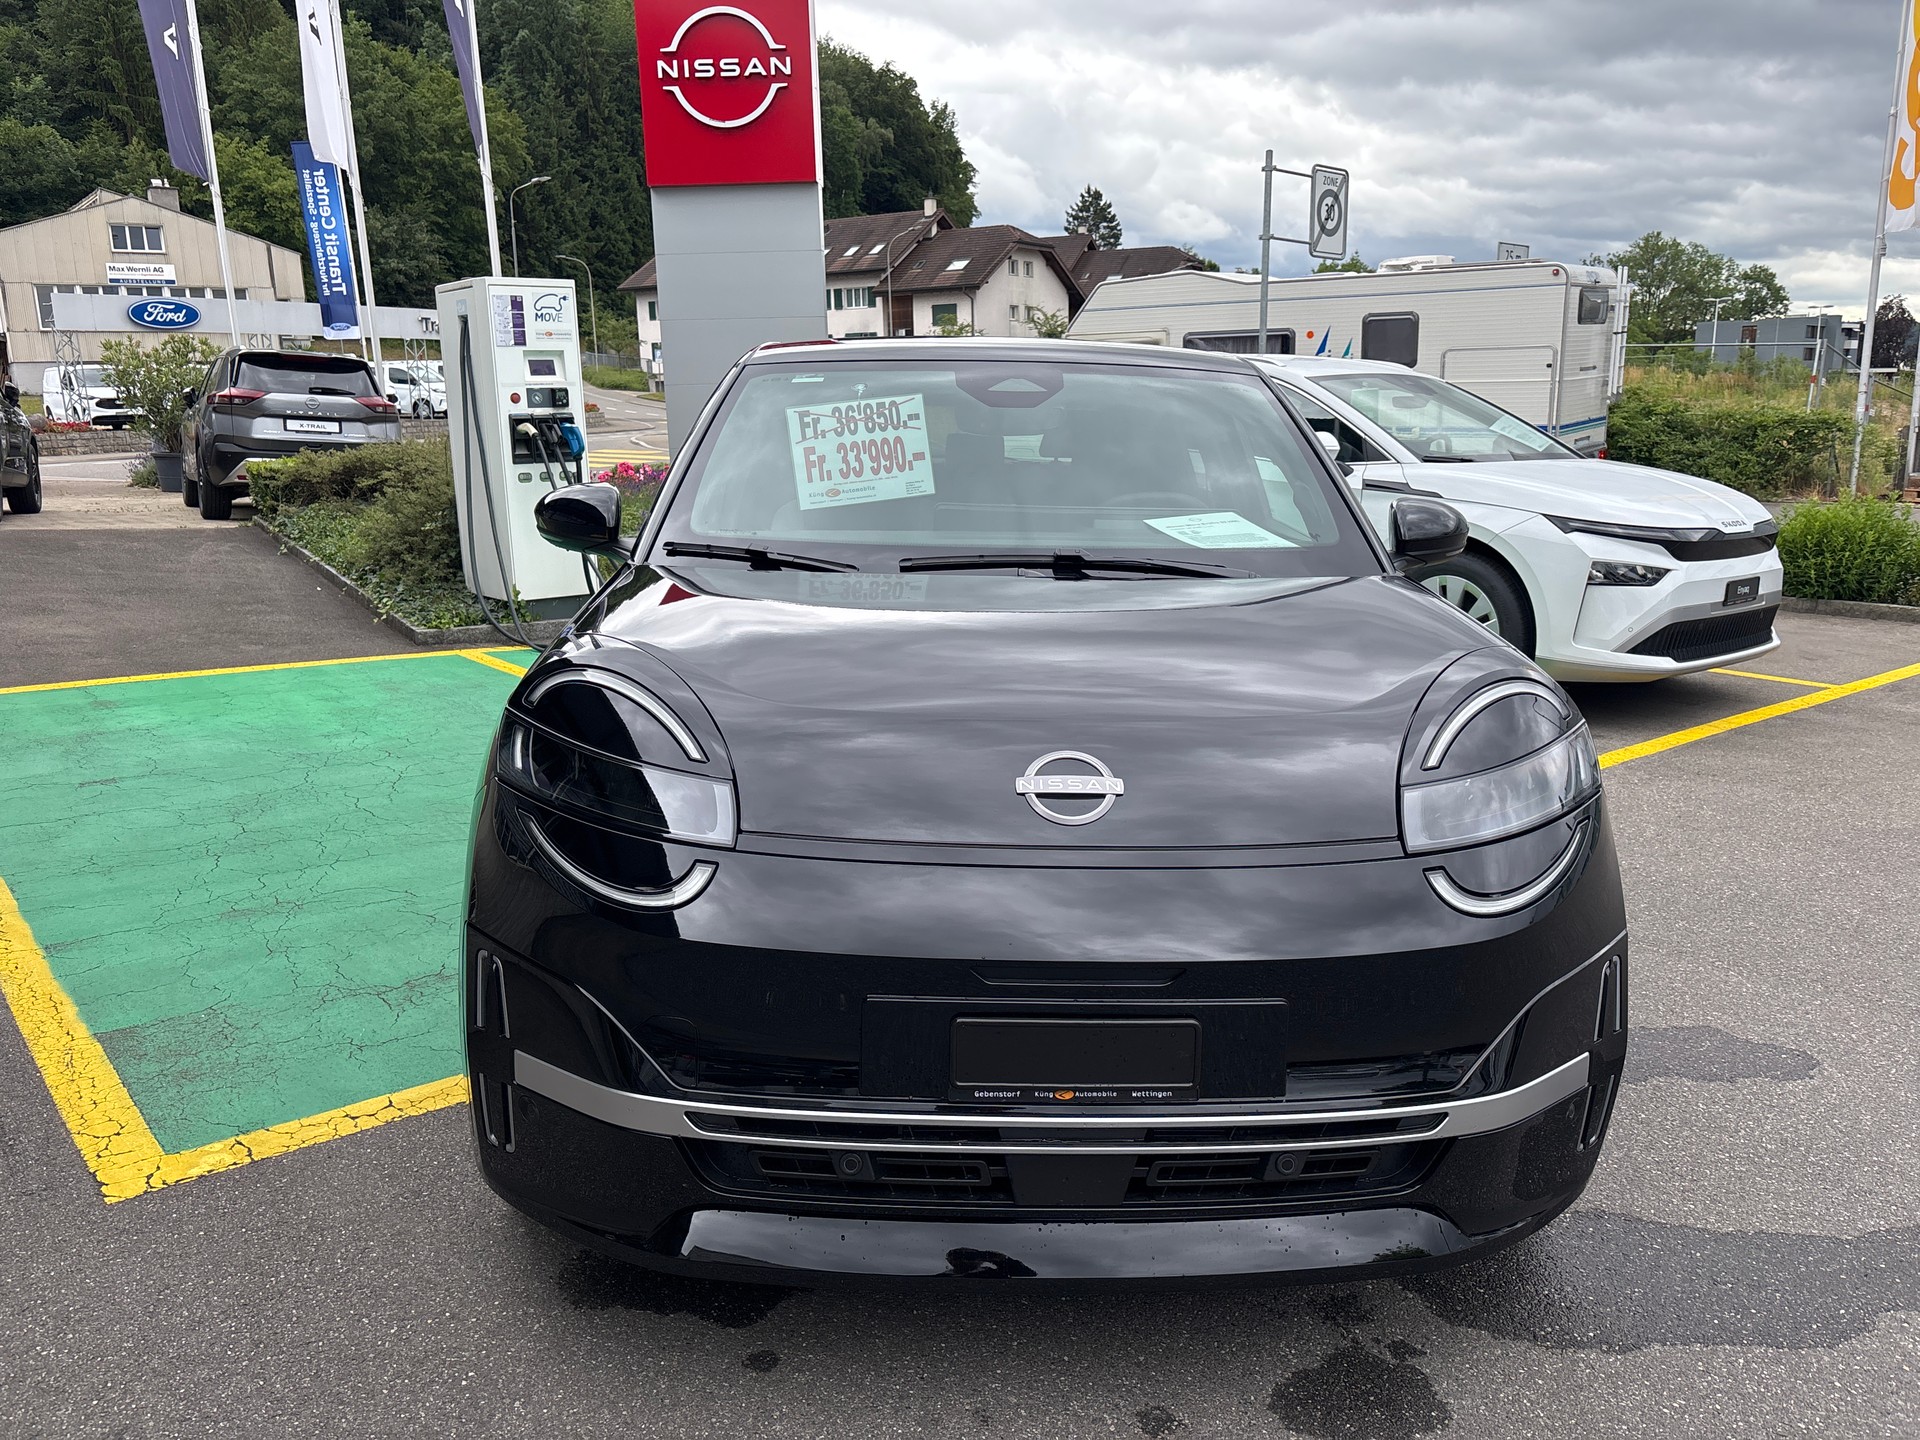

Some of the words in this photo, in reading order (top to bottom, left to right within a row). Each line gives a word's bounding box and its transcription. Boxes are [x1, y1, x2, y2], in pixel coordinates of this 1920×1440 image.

[656, 56, 792, 79] NISSAN
[1322, 175, 1339, 187] ZONE
[1324, 203, 1335, 222] 30
[108, 265, 125, 273] Max
[143, 302, 187, 323] Ford
[535, 312, 563, 323] MOVE
[797, 410, 827, 440] Fr.
[803, 446, 833, 484] Fr.
[841, 485, 876, 494] Automobile
[1737, 585, 1750, 595] Enyaq
[1019, 779, 1121, 792] NISSAN
[974, 1090, 1021, 1098] Gebenstorf
[1034, 1090, 1054, 1099] Küng
[1075, 1090, 1118, 1098] Automobile
[1132, 1090, 1173, 1099] Wettingen
